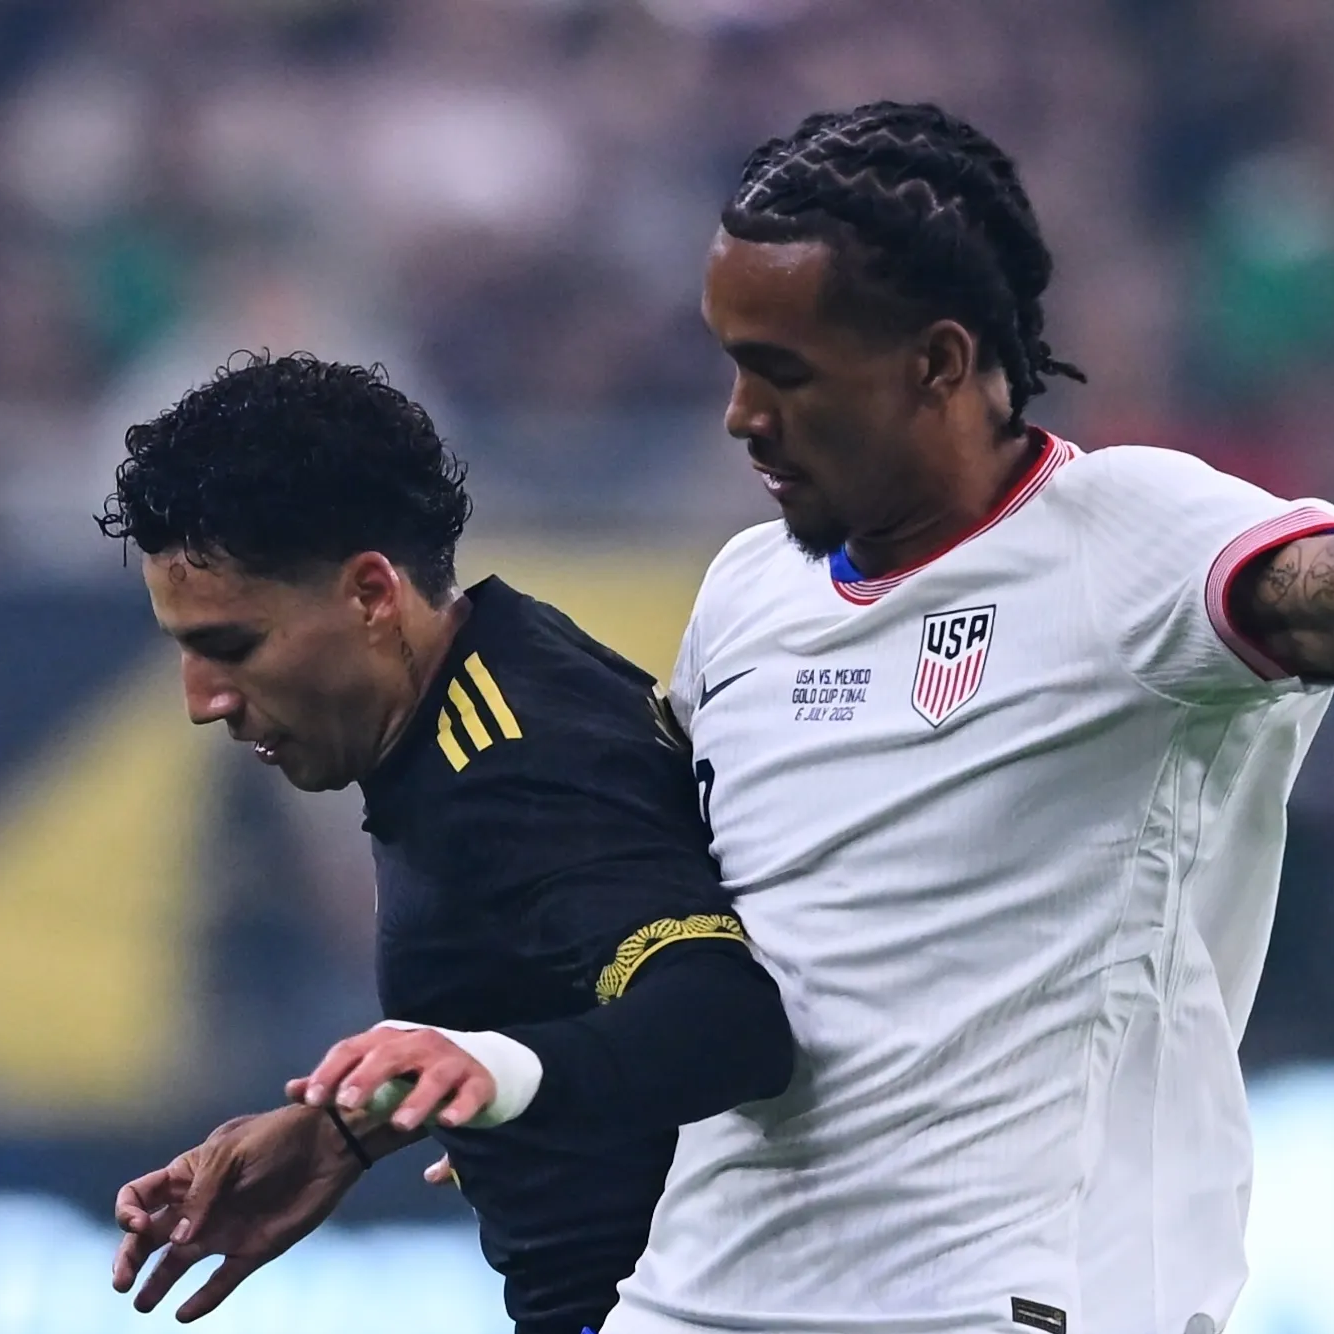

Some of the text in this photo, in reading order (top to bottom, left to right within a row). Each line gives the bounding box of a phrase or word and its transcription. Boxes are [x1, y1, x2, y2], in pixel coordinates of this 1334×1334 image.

[927, 613, 989, 660] USA
[795, 668, 815, 685] USA
[834, 668, 871, 685] MEXICO
[792, 687, 867, 704] GOLD CUP FINAL
[794, 705, 856, 721] 6 JULY 2025
